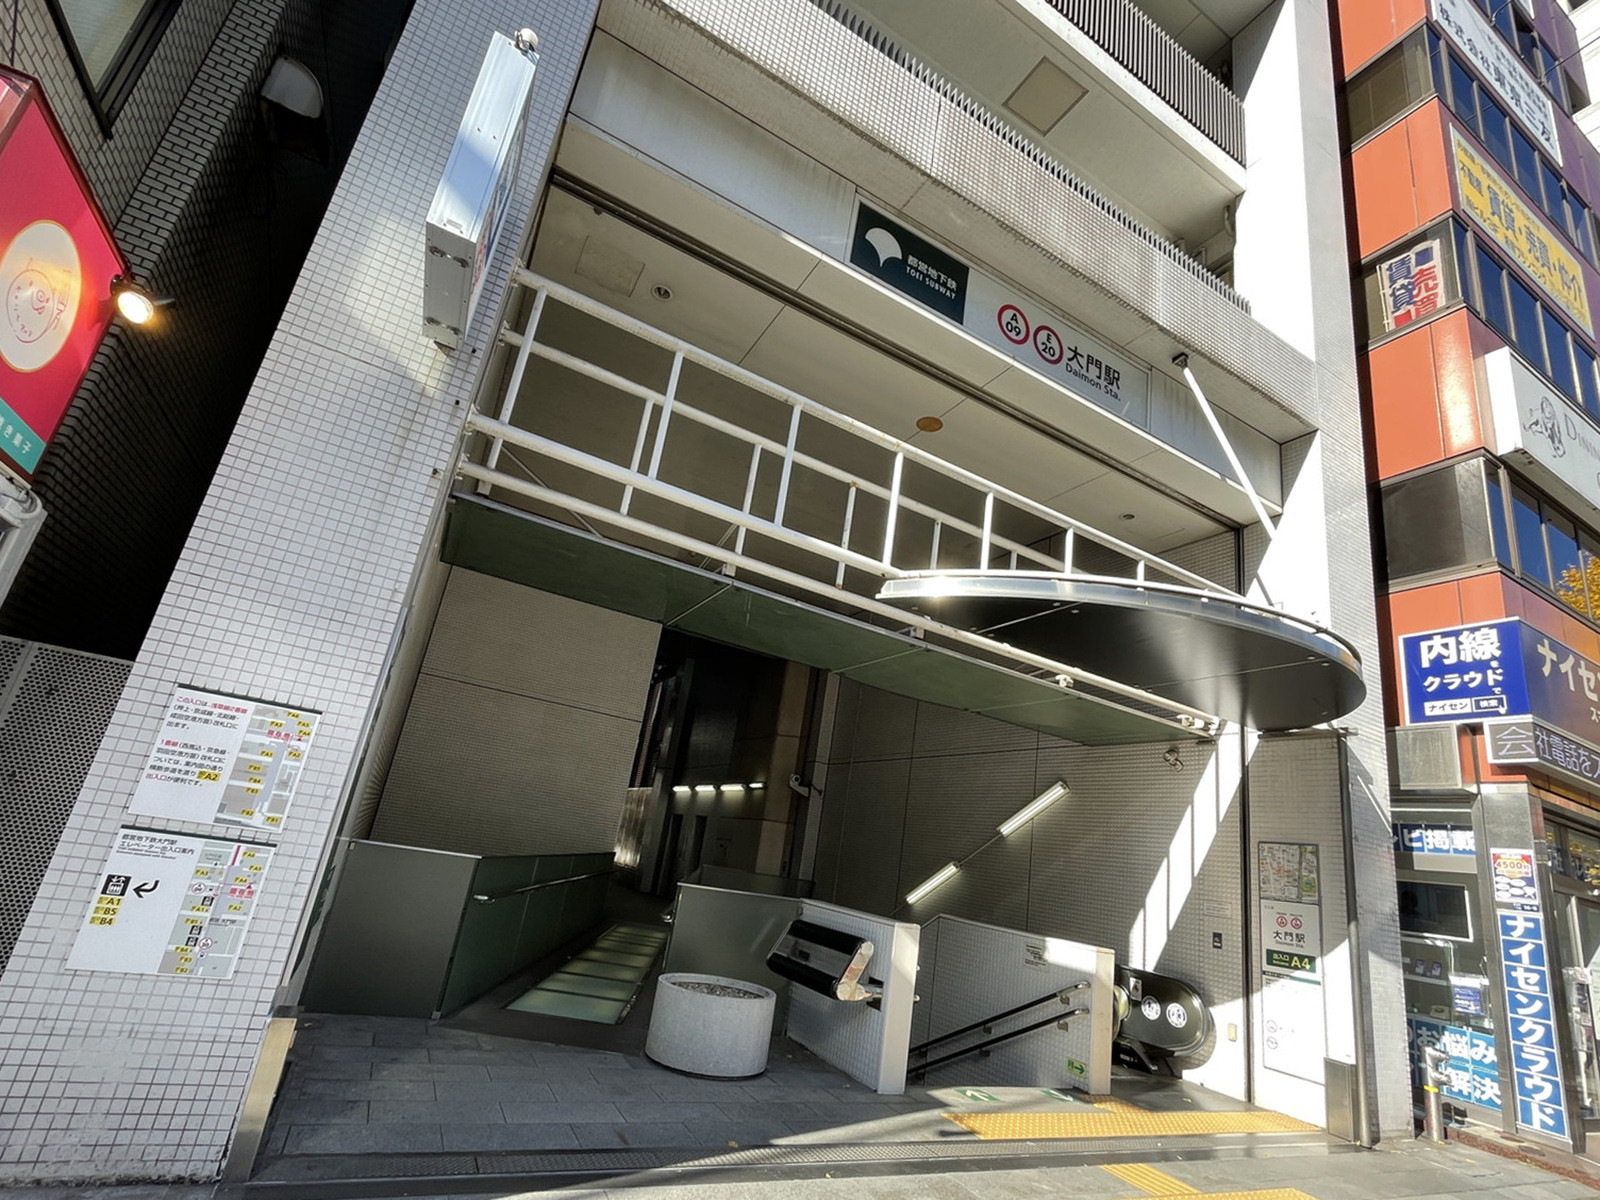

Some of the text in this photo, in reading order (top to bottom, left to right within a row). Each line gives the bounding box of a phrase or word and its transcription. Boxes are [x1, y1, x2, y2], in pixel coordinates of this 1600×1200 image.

[905, 266, 956, 299] TOEI SUBWAY
[906, 255, 958, 291] 都営地下鉄
[1386, 254, 1416, 315] 賃貸
[1413, 265, 1440, 318] 売買
[1005, 321, 1021, 337] 09
[1010, 313, 1019, 325] A
[1046, 333, 1053, 345] E
[1041, 342, 1056, 358] 20
[1067, 346, 1121, 390] 大門駅
[1065, 362, 1121, 401] Daimon Sta.
[1420, 627, 1502, 668] 内線
[1423, 668, 1504, 692] クラウド
[1537, 638, 1600, 702] ナイセ
[1428, 699, 1469, 712] ナイセン
[103, 908, 117, 916] B5
[107, 898, 121, 906] A1
[99, 918, 113, 926] B4
[1272, 930, 1306, 944] 大門駅
[1291, 956, 1311, 970] A4
[1505, 915, 1556, 1130] ナイセンクラウド
